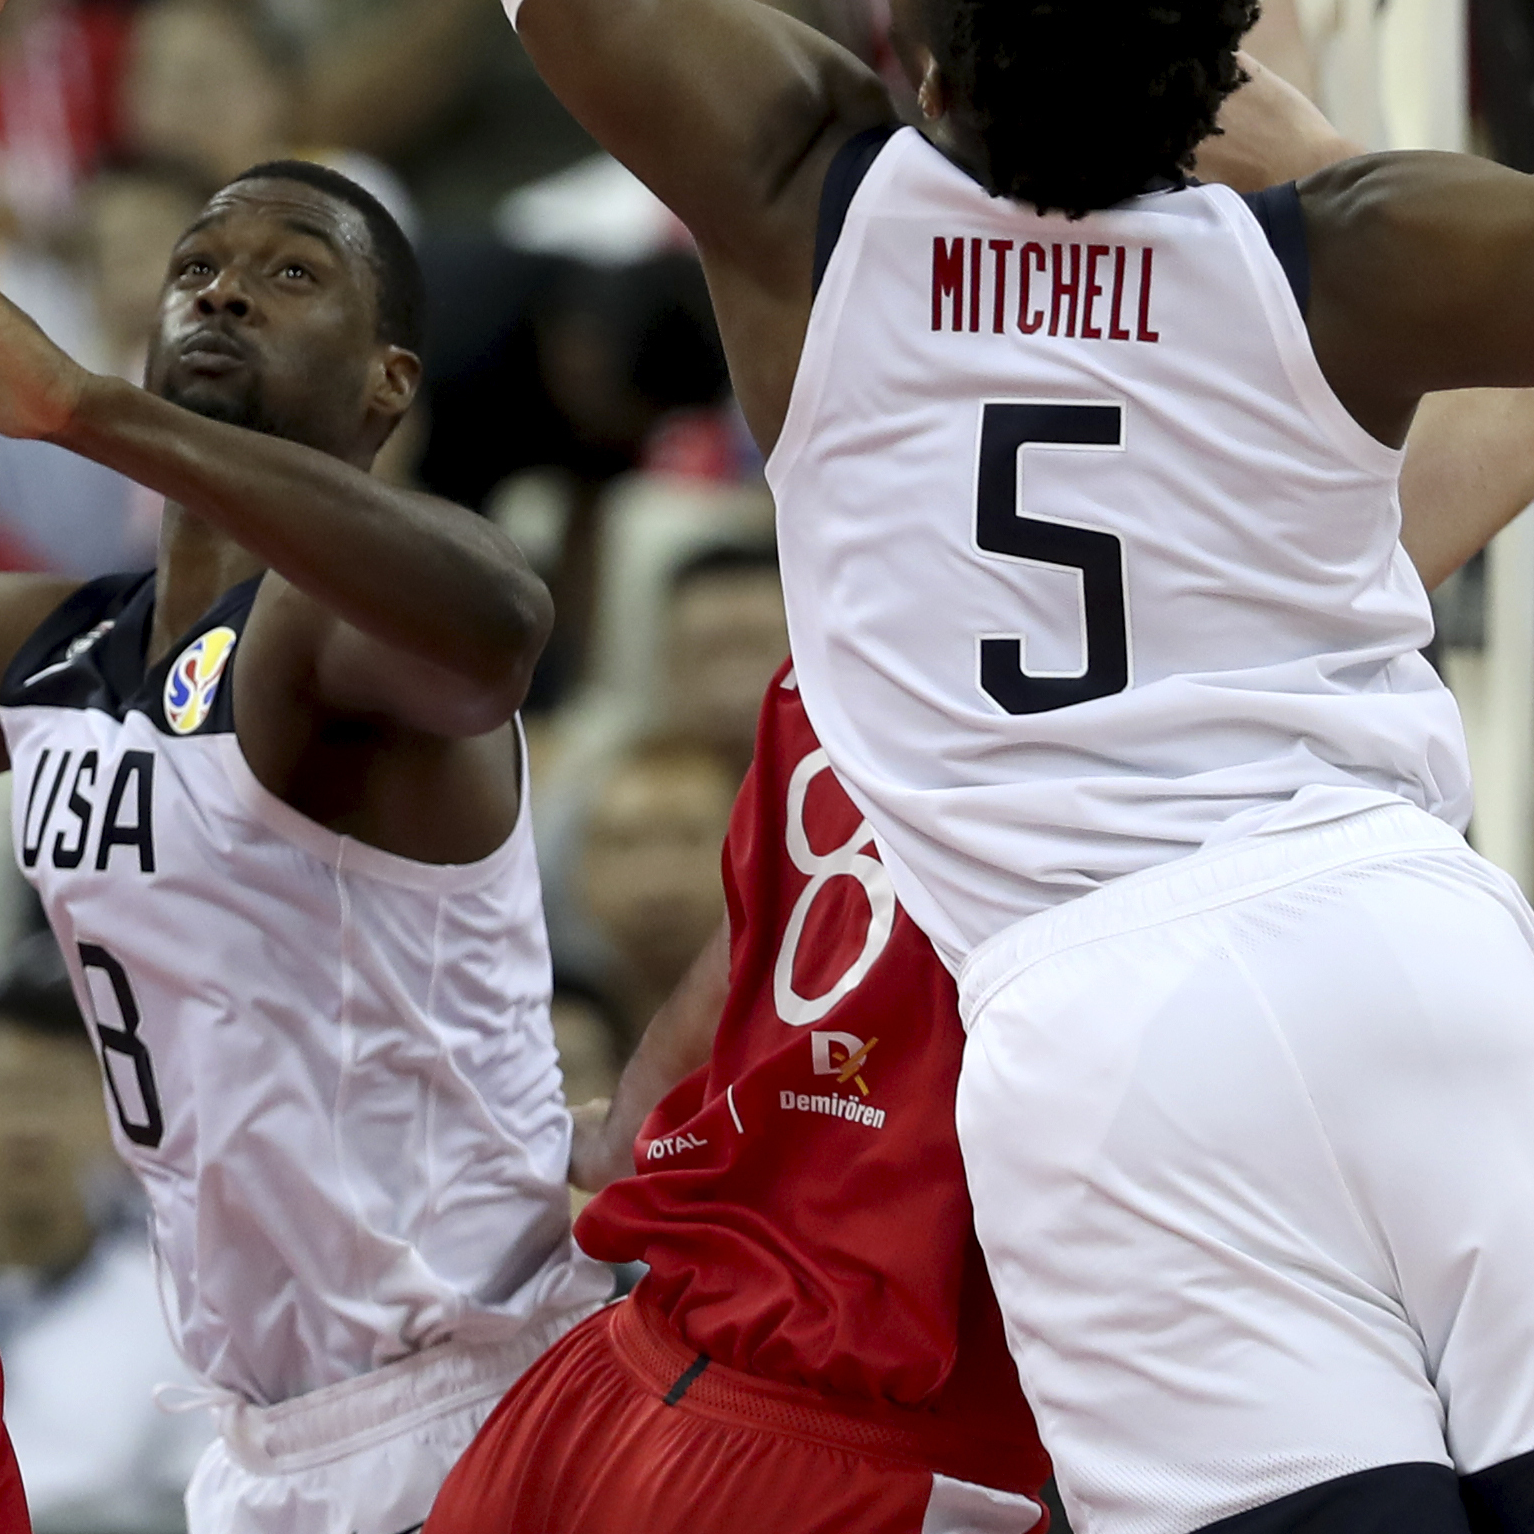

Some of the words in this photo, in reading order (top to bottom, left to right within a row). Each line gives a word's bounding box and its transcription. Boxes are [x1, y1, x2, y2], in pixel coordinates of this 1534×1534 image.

[931, 236, 1159, 343] MITCHELL
[976, 402, 1128, 716] 5
[23, 749, 156, 873] USA
[779, 1090, 886, 1129] Demirören
